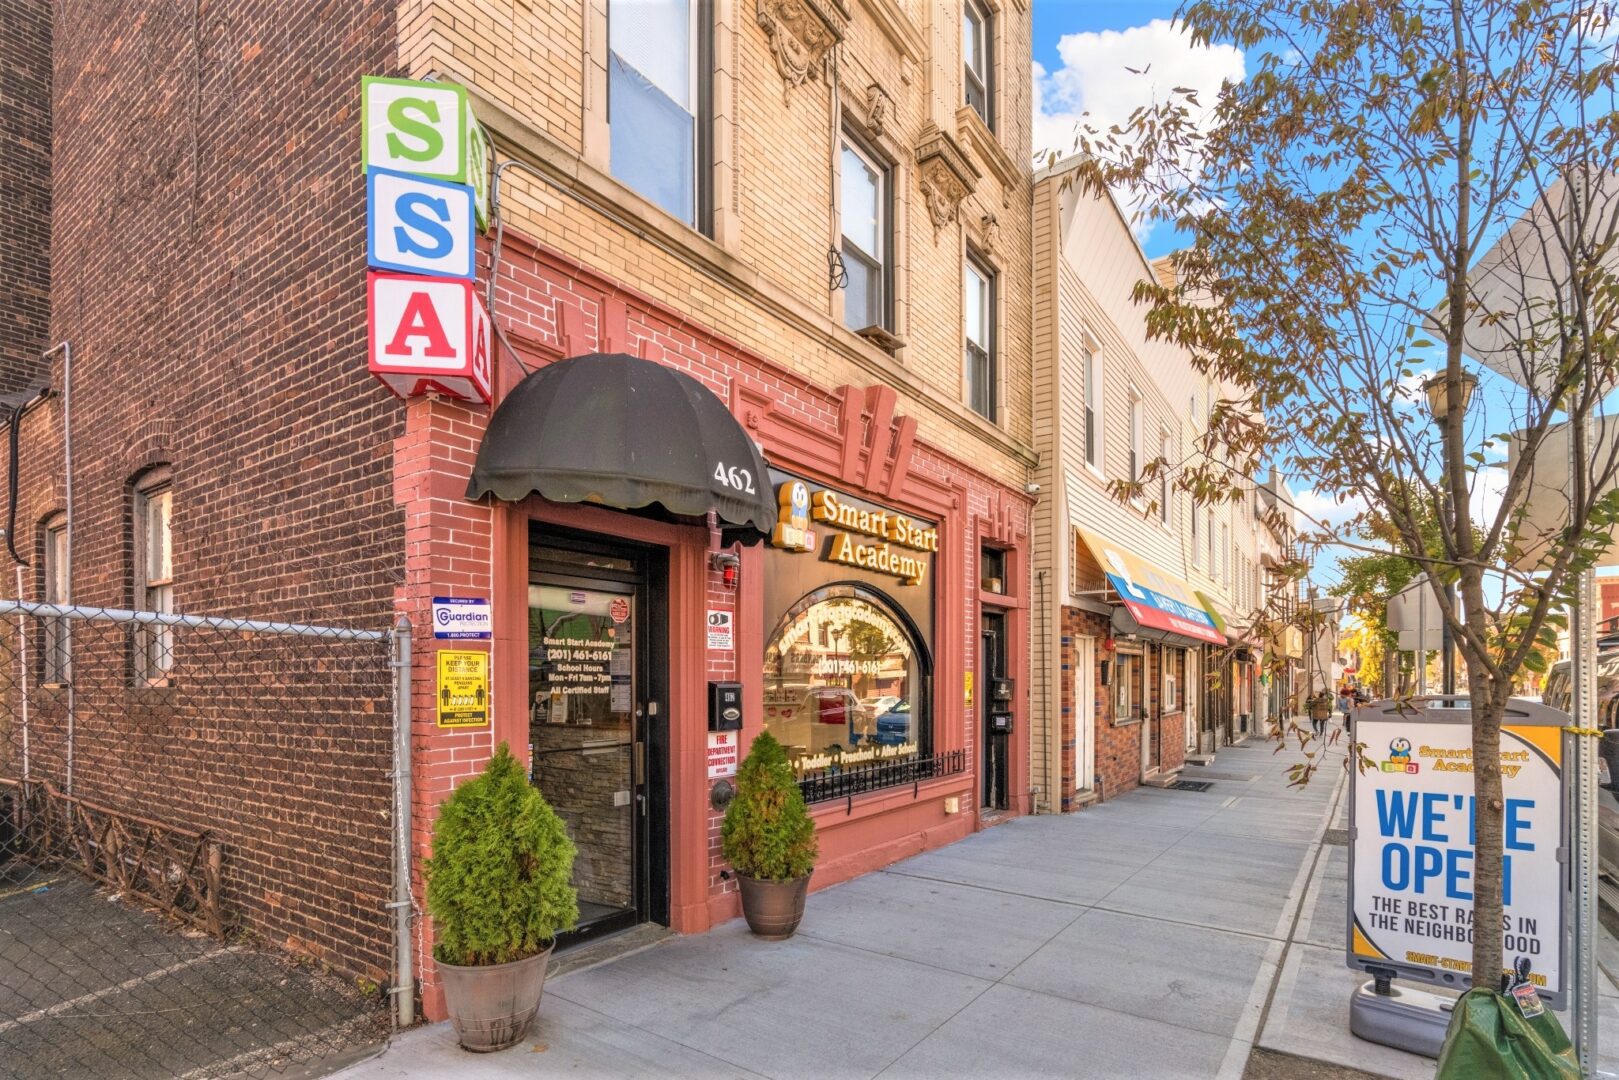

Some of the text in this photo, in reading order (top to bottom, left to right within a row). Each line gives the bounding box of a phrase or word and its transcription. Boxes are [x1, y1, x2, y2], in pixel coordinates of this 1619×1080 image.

[386, 97, 444, 162] S
[393, 192, 454, 259] S
[385, 292, 457, 358] A
[474, 314, 489, 383] A
[714, 462, 755, 495] 462
[823, 490, 939, 552] Smart Start
[838, 532, 927, 586] Academy
[440, 611, 489, 621] Guardian
[543, 636, 615, 650] Smart Start Academy
[547, 648, 612, 662] (201) 461-6161
[557, 663, 604, 672] School Hours
[548, 674, 564, 682] Mon
[568, 674, 578, 682] Fri
[597, 674, 612, 683] 7pm
[550, 686, 610, 694] All Certified Staff
[716, 735, 728, 744] FIRE
[708, 746, 736, 756] DEPARTMENT
[802, 753, 832, 770] Toddler
[840, 747, 874, 764] Preschool
[881, 744, 897, 758] After
[898, 741, 918, 755] School
[1418, 745, 1473, 759] Smart
[708, 756, 736, 766] CONNECTION
[1432, 759, 1521, 778] Acay
[1372, 896, 1537, 936] THE BEST RAS IN
[1368, 912, 1541, 955] THE NEIGHBOOOD
